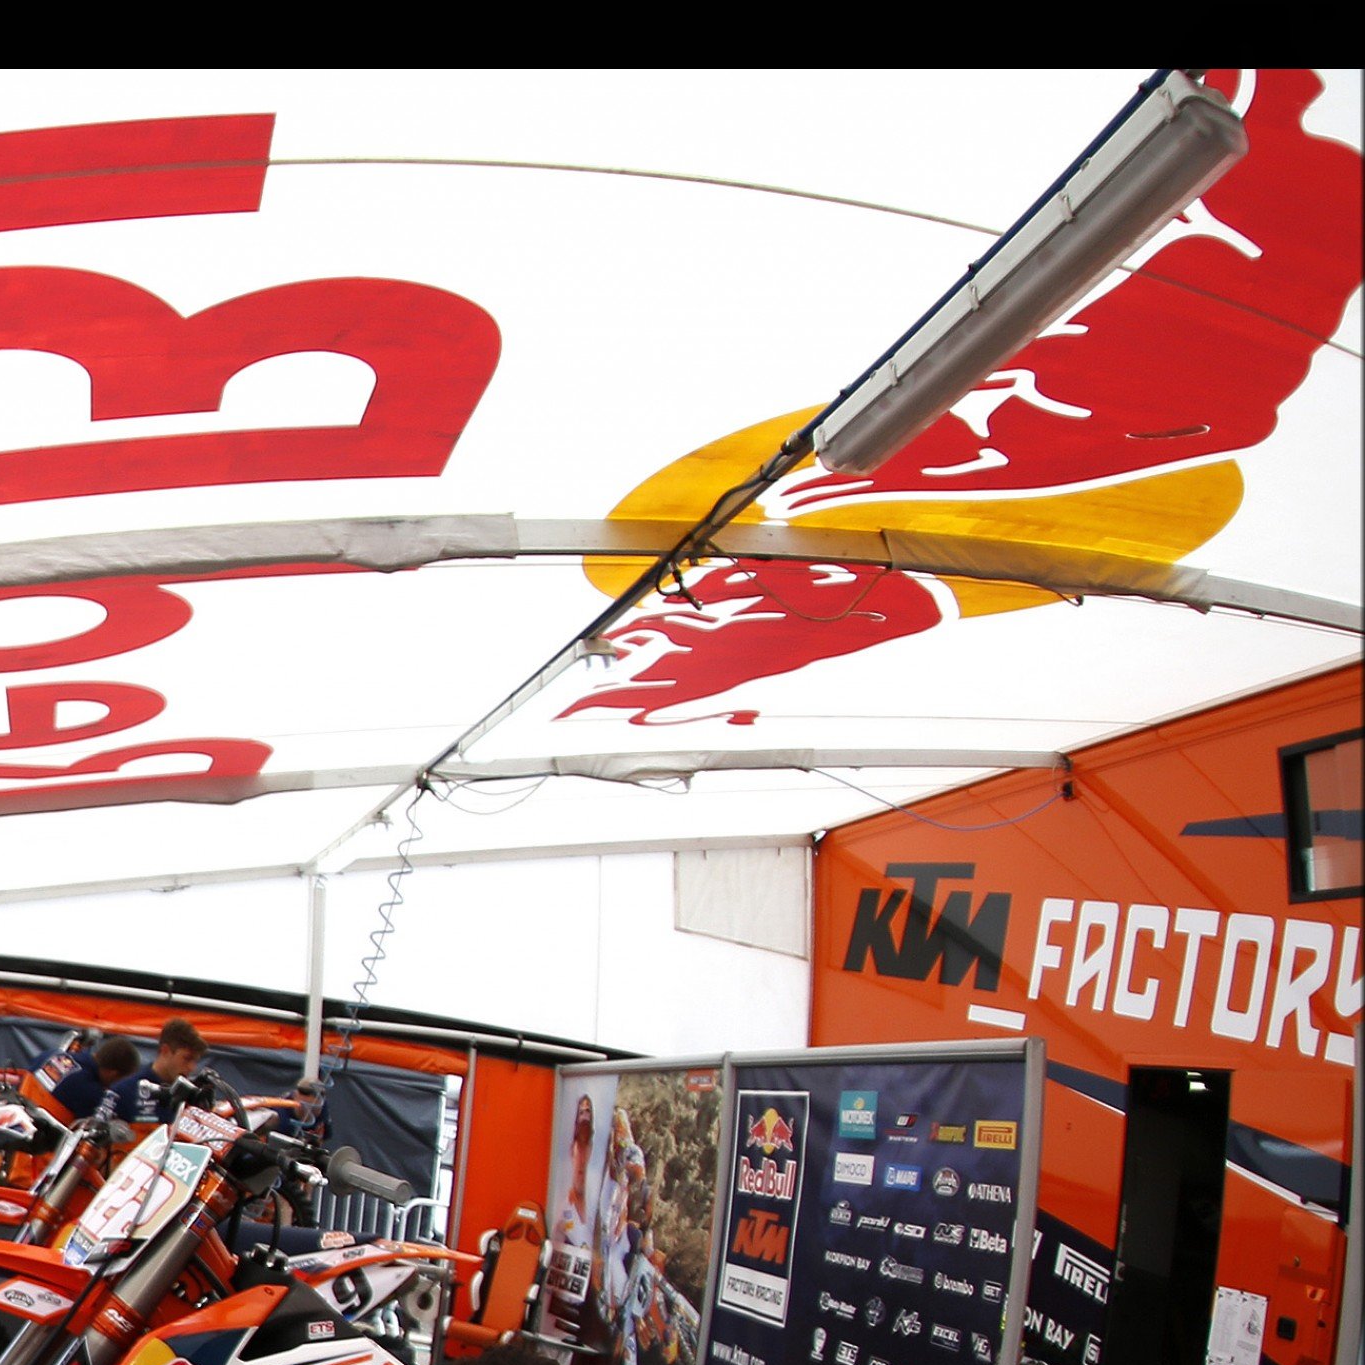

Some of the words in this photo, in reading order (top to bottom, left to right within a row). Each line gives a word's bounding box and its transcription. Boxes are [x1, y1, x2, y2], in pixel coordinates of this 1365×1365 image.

[843, 862, 1012, 993] KTM
[977, 1125, 1013, 1145] PIRELLI
[738, 1155, 769, 1196] Red
[767, 1157, 797, 1200] Bull
[976, 1184, 1013, 1204] ATHENA
[731, 1207, 790, 1265] KTM
[981, 1232, 1008, 1254] Beta
[856, 1256, 871, 1271] BAY
[943, 1274, 974, 1296] brembo
[1023, 1305, 1043, 1334] ON
[1045, 1317, 1075, 1351] BAY
